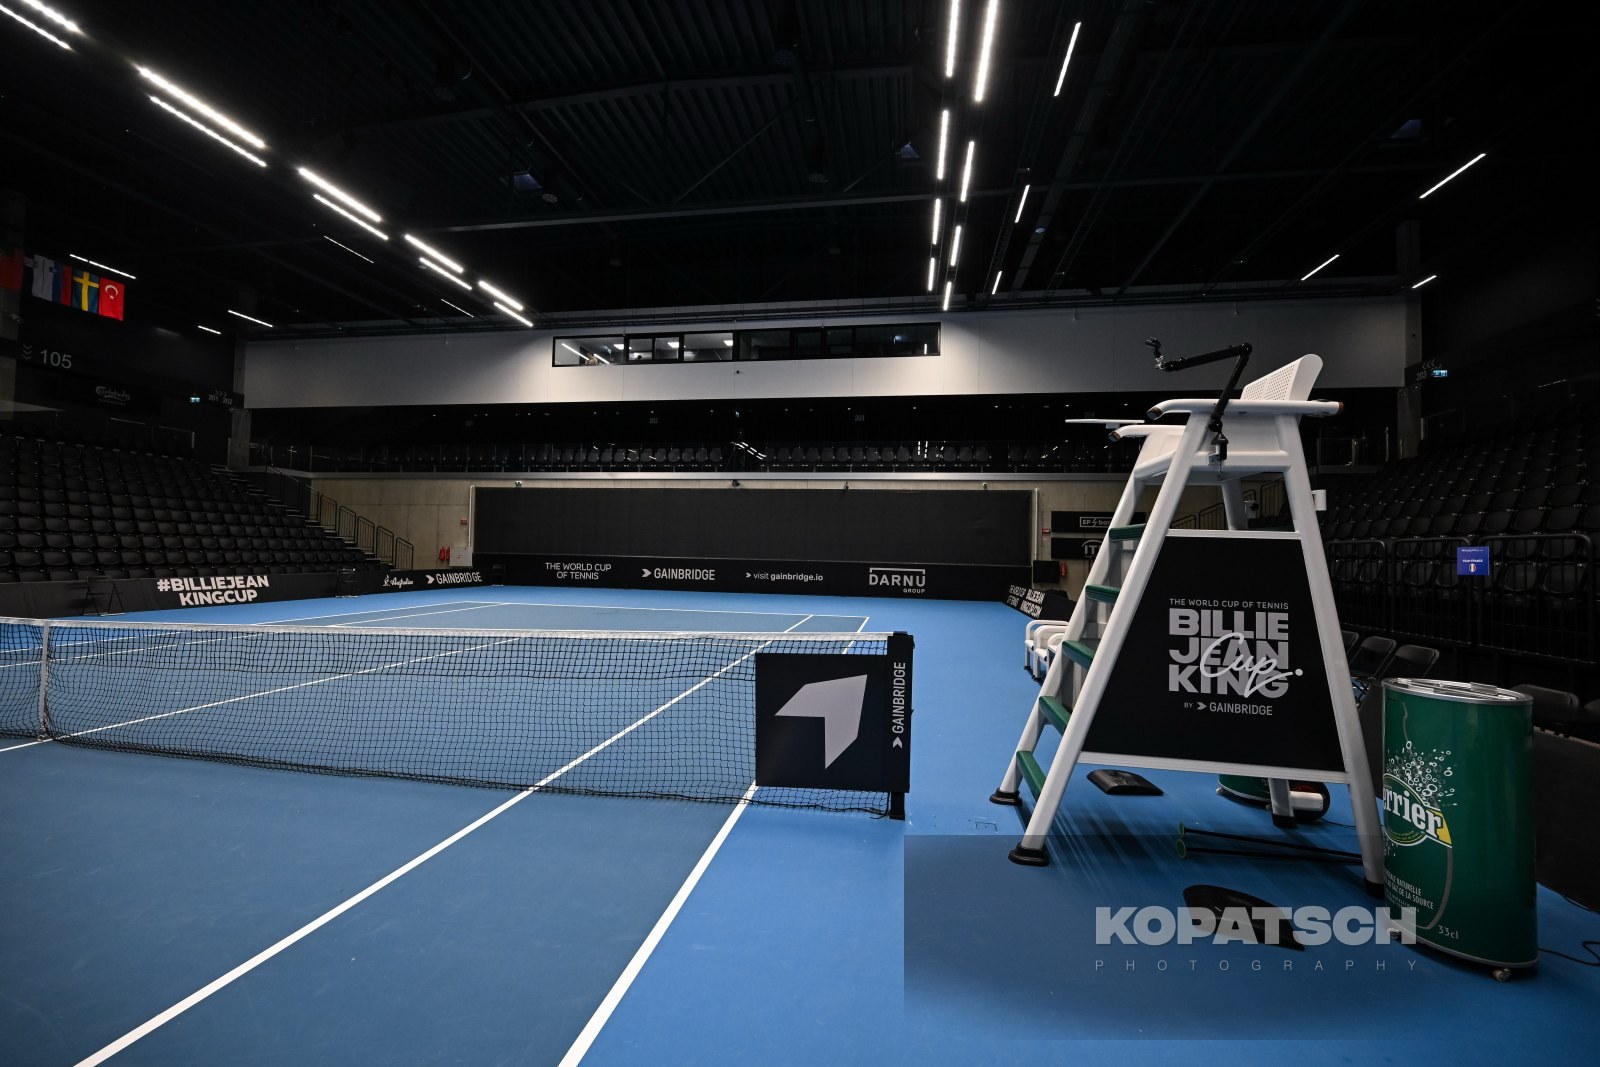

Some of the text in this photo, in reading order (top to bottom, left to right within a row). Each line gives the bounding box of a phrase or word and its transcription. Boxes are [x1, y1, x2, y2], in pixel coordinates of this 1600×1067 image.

[40, 349, 72, 369] 105
[208, 394, 219, 402] 201
[1084, 544, 1099, 555] IT
[544, 562, 612, 572] THE WORLD CUP
[653, 567, 716, 581] GAINBRIDGE
[157, 575, 270, 592] #BILLIEJEAN
[435, 572, 482, 585] GAINBRIDGE
[556, 571, 599, 580] OF TENNIS
[753, 572, 824, 582] visit gainbridge.io
[179, 589, 258, 606] KINGCUP
[1169, 598, 1186, 606] THE
[1188, 599, 1219, 607] WORLD
[1221, 600, 1240, 608] CUP
[1256, 601, 1289, 610] TENNIS
[1168, 608, 1289, 640] BILLIE
[1168, 637, 1289, 670] JEAN
[1168, 663, 1289, 699] KING
[891, 661, 906, 734] GAINBRIDGE
[1183, 701, 1273, 716] BY GAINBRIDGE
[1383, 787, 1441, 839] errier
[1405, 890, 1412, 901] LA
[1412, 894, 1434, 910] SOURCE
[1437, 924, 1460, 940] 33cl
